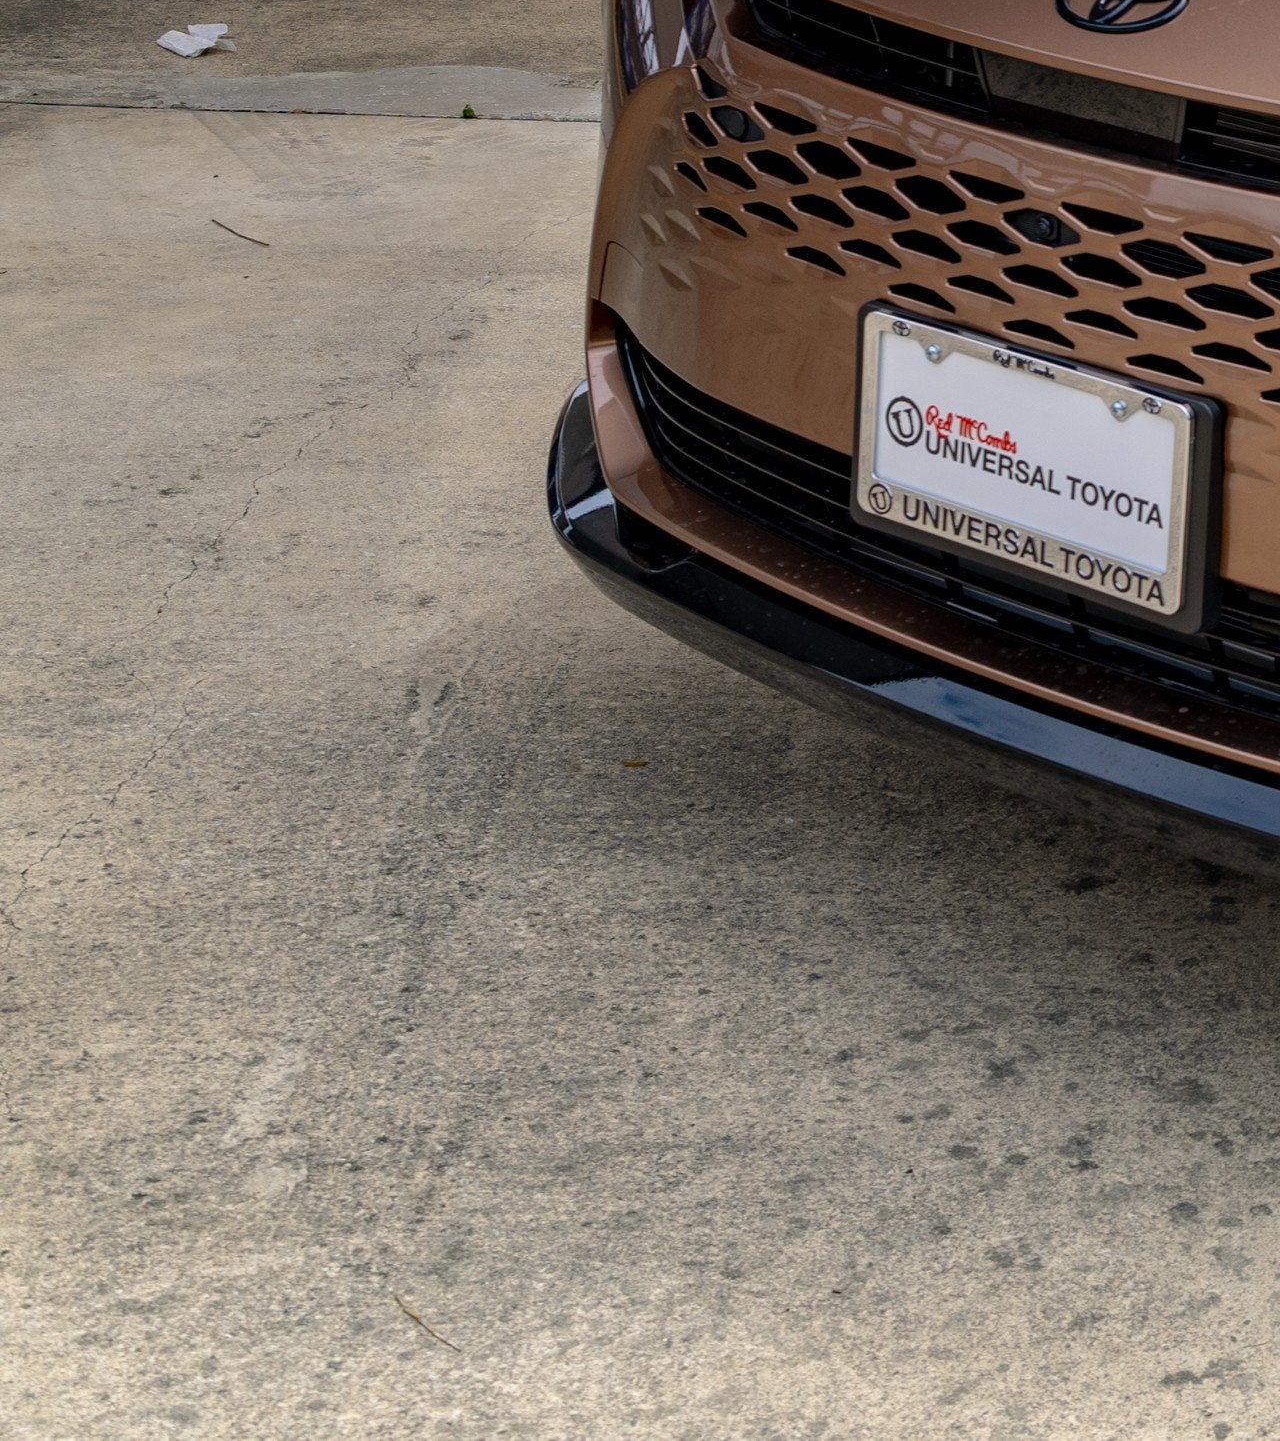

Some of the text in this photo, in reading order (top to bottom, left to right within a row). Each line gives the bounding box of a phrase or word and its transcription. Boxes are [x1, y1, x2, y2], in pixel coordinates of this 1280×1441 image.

[926, 405, 1017, 454] Red McCombs
[925, 430, 1164, 529] UNIVERSAL TOYOTA
[902, 495, 1056, 568] UNIVERSAL
[1059, 547, 1165, 607] TOYOTA
